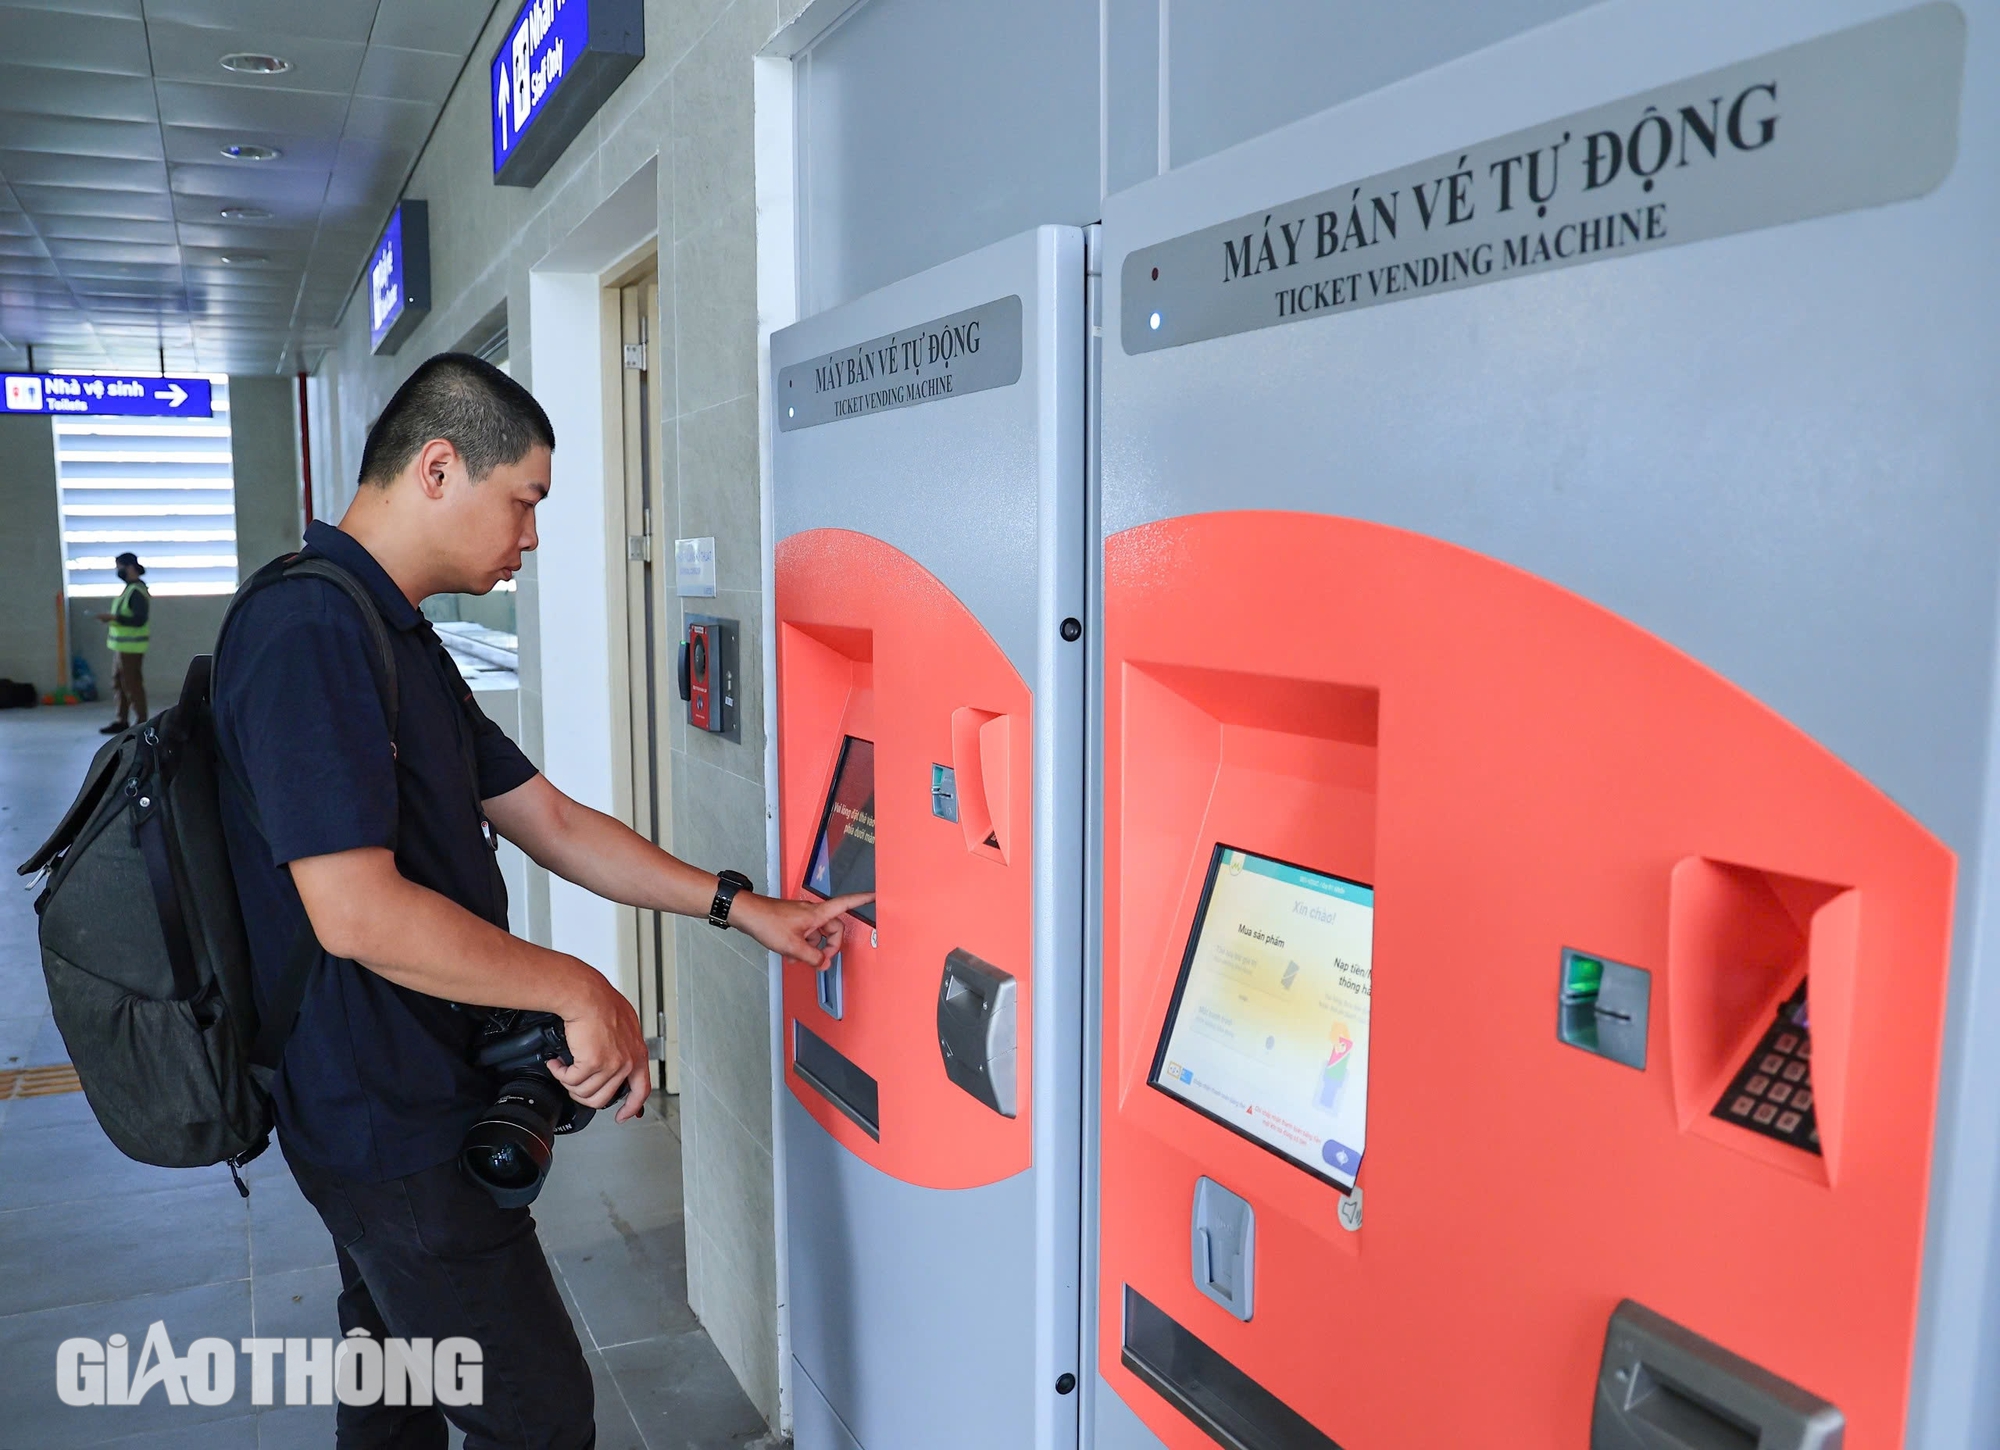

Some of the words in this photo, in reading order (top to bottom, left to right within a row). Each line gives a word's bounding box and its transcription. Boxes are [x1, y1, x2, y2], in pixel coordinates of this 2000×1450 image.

[531, 55, 547, 107] Staff
[546, 36, 564, 83] Only
[1222, 214, 1305, 282] MÁY
[1314, 187, 1400, 259] BÁN
[1412, 155, 1476, 231] VÉ
[1489, 131, 1571, 219] TỰ
[1582, 80, 1780, 193] ĐỘNG
[1275, 273, 1362, 317] TICKET
[1368, 243, 1493, 296] VENDING
[1502, 203, 1668, 270] MACHINE
[815, 357, 844, 393] MÁY
[847, 347, 875, 385] BÁN
[878, 337, 898, 376] VÉ
[901, 332, 925, 376] TỰ
[928, 321, 980, 369] ĐỘNG
[44, 378, 81, 396] Nhà
[83, 380, 105, 399] vệ
[107, 381, 145, 397] sinh
[834, 395, 864, 416] TICKET
[864, 386, 904, 409] VENDING
[906, 374, 953, 401] MACHINE
[1292, 900, 1309, 916] Xin
[1309, 906, 1337, 925] chào!
[1238, 923, 1252, 937] Mua
[1253, 929, 1265, 941] sản
[1265, 934, 1285, 949] phẩm
[1333, 957, 1349, 973] Nạp
[1338, 976, 1360, 994] thông
